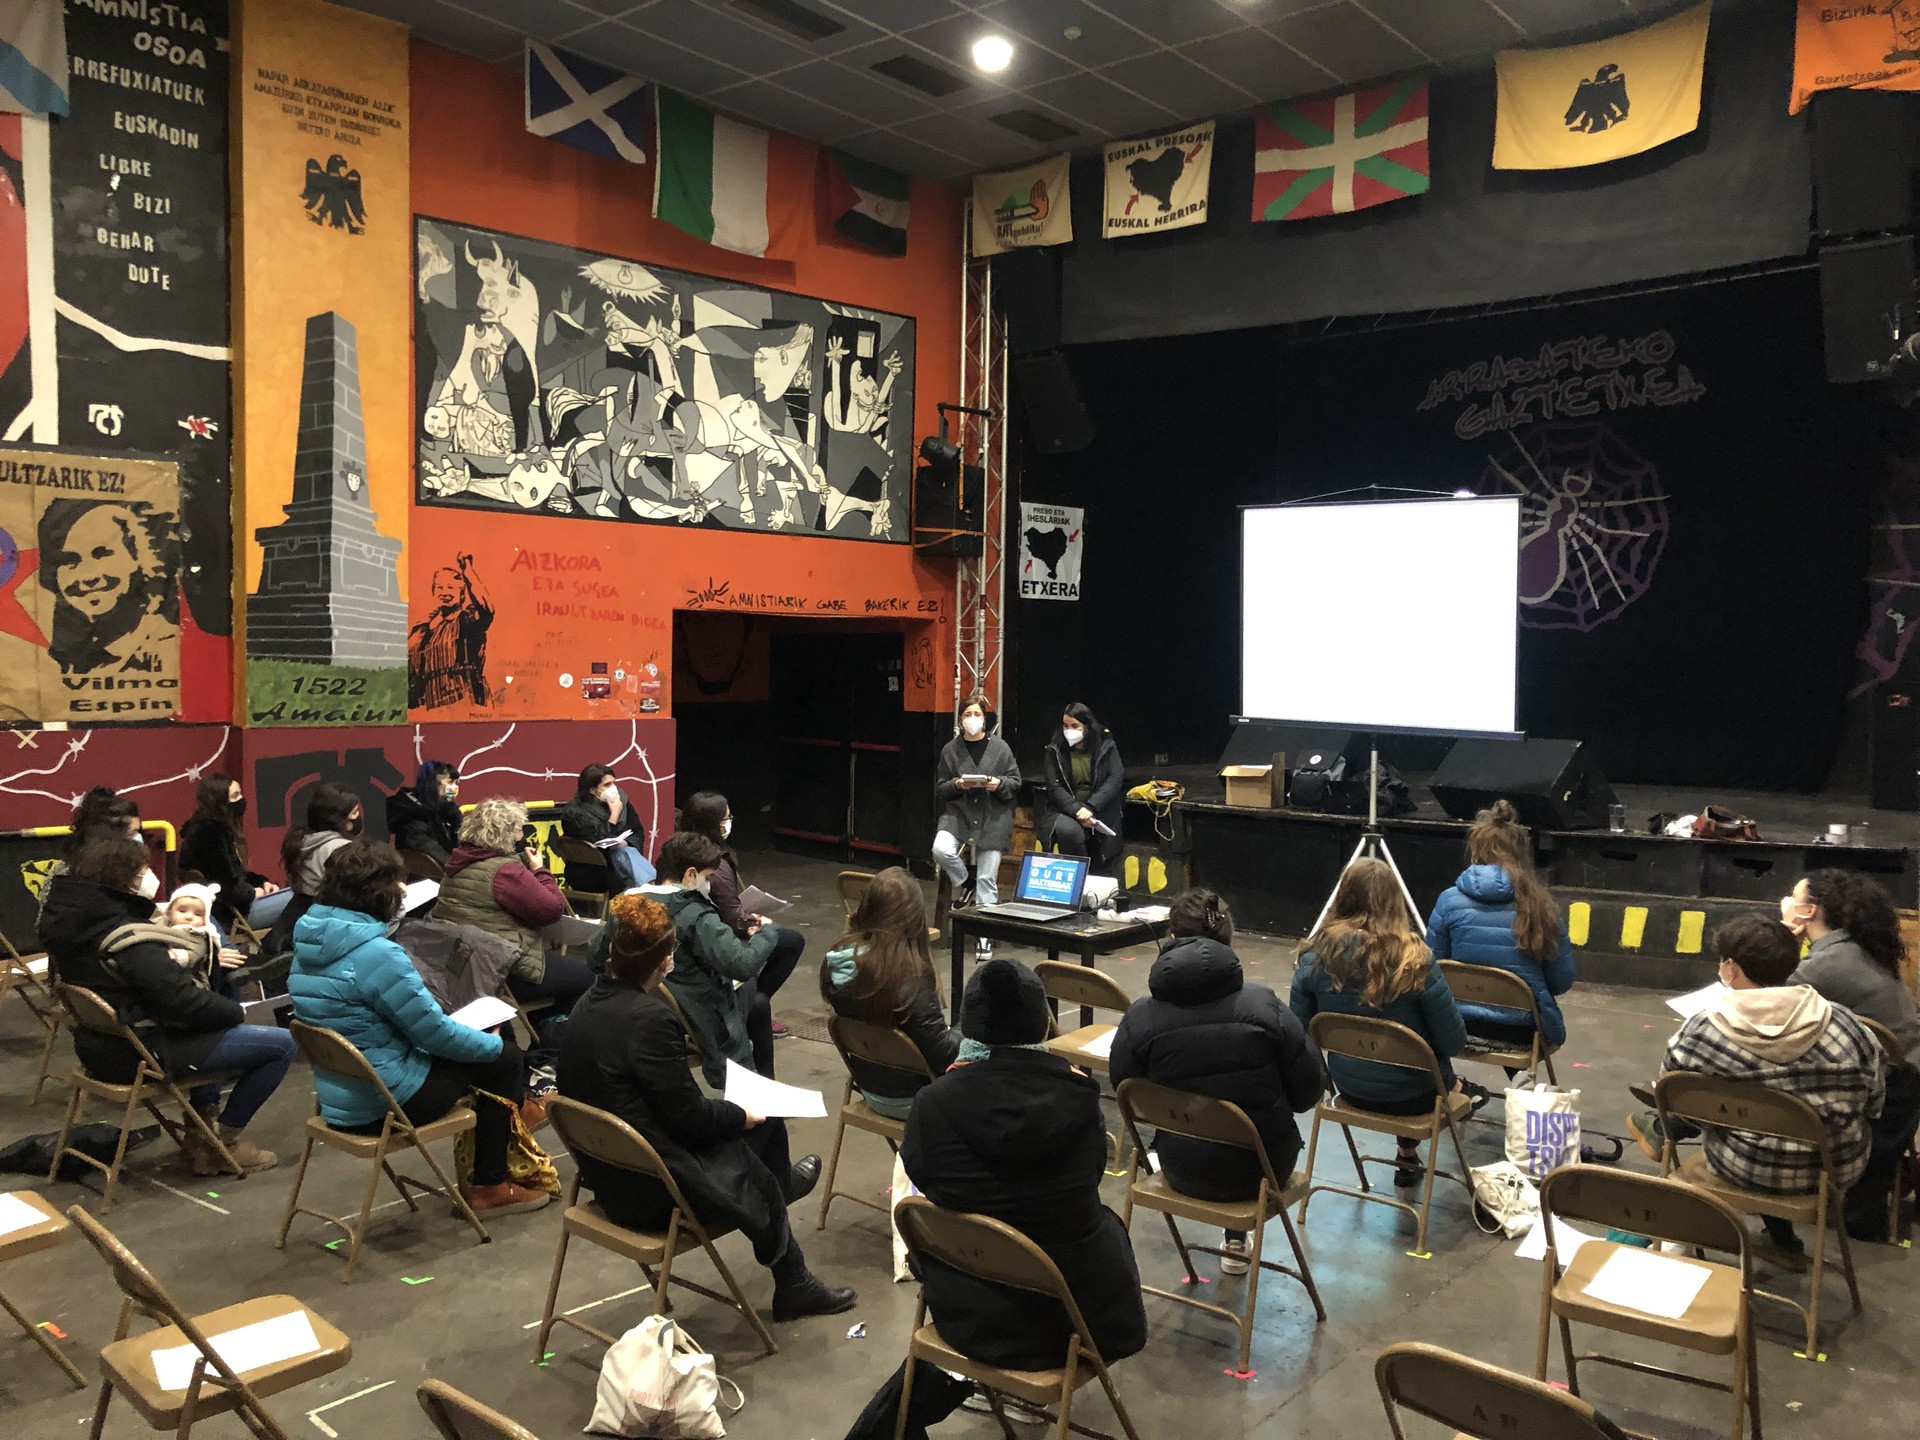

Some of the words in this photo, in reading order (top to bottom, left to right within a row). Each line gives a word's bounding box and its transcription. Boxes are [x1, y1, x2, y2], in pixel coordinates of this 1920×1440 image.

[75, 0, 207, 35] MNISTIA
[133, 31, 207, 69] OSOA
[67, 54, 205, 107] RREFUXIATUEK
[114, 110, 199, 149] EUSKADIN
[1107, 143, 1152, 163] EUSKAL
[1155, 131, 1211, 148] PRESOAK
[99, 153, 152, 178] LIBRE
[133, 193, 171, 214] BIZI
[1107, 217, 1150, 229] EUSKAL
[1154, 200, 1207, 226] HERRIRA
[96, 228, 155, 253] BEHAR
[128, 263, 171, 291] DUTE
[97, 470, 126, 493] EZ!
[1033, 507, 1053, 515] PRESO
[510, 549, 602, 573] AIZKORA
[533, 576, 565, 592] ETA
[1021, 580, 1079, 597] ETXERA
[728, 593, 808, 610] AMNISTIARIK
[816, 599, 848, 611] GABE
[864, 599, 910, 611] BAKERIK
[61, 676, 179, 691] Vilma
[292, 677, 368, 695] 1522
[251, 702, 403, 722] Amaiur
